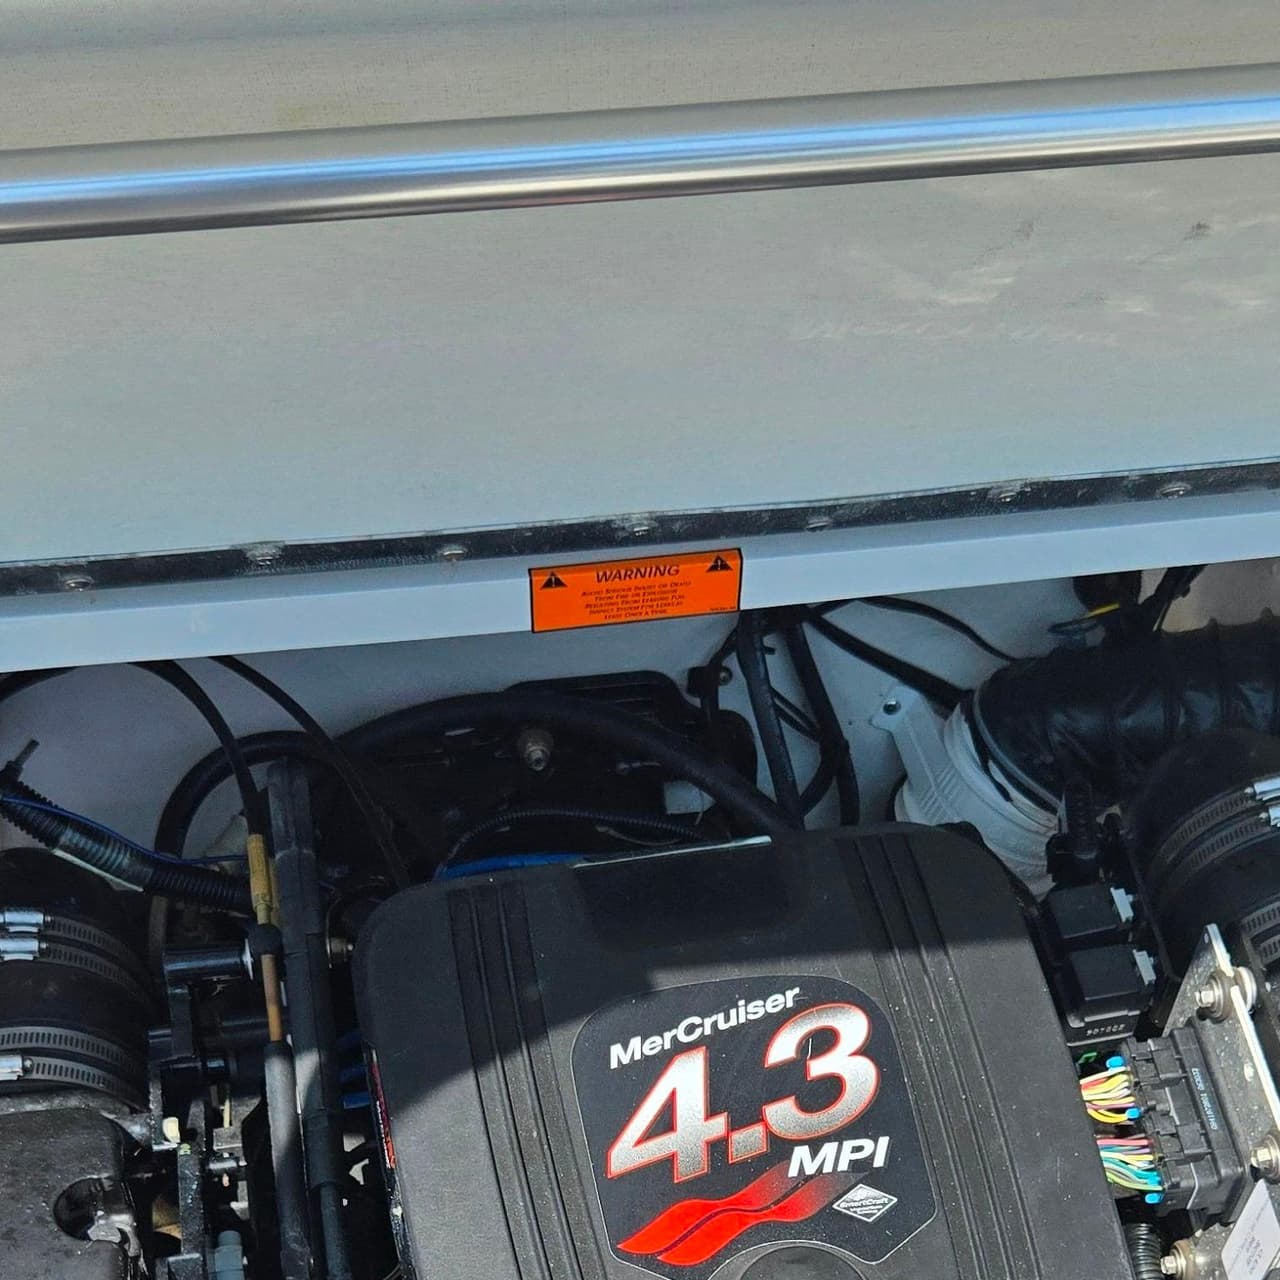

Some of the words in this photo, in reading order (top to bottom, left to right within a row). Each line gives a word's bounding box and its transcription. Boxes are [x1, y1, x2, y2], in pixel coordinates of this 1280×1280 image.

[595, 564, 680, 583] WARNING
[609, 986, 801, 1070] MerCruiser
[604, 1001, 881, 1183] 4.3
[787, 1135, 890, 1178] MPI
